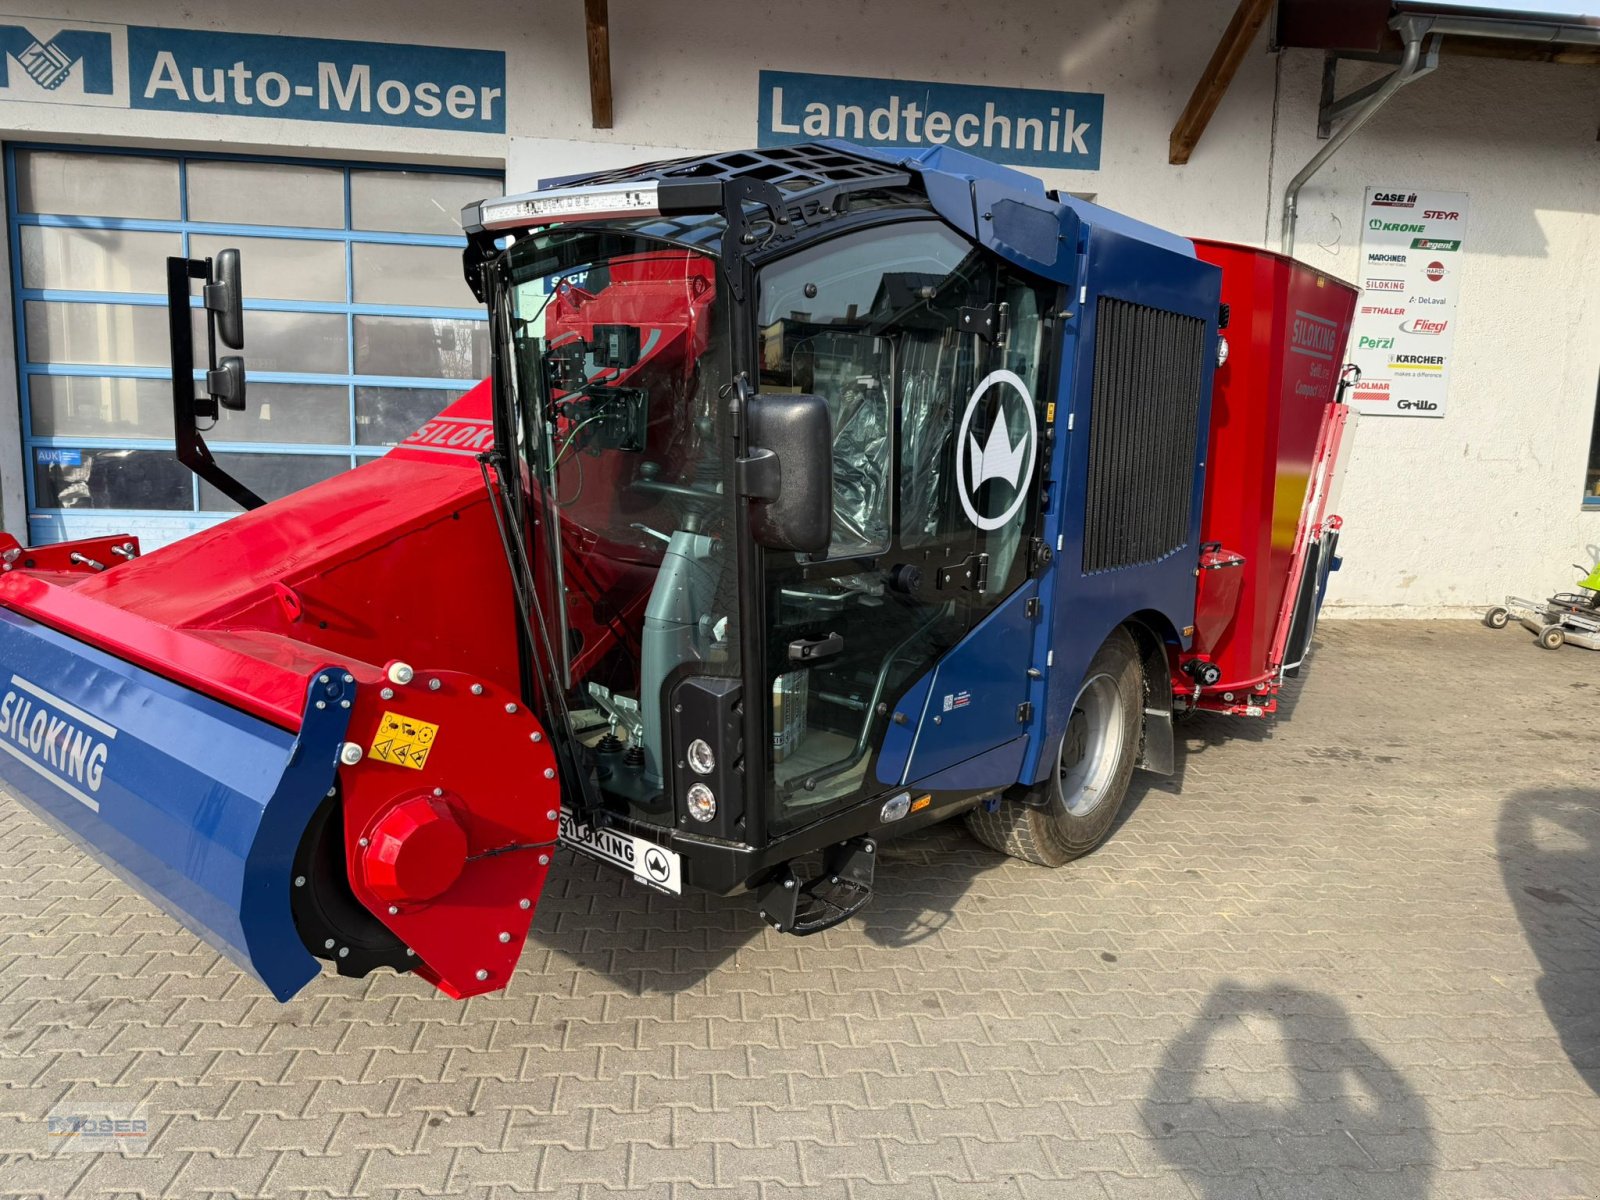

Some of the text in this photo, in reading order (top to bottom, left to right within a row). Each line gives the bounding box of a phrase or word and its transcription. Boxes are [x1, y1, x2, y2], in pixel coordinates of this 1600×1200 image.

[143, 50, 501, 120] Auto-Moser
[771, 86, 1092, 155] Landtechnik
[1374, 192, 1405, 202] CASE
[1422, 210, 1459, 221] STEYR
[1382, 222, 1425, 233] KRONE
[1418, 239, 1454, 250] Regent
[1366, 280, 1405, 290] SILOKING
[1418, 296, 1447, 305] DeLaval
[1371, 306, 1405, 316] THALER
[1412, 319, 1448, 334] Fliegl
[1291, 319, 1337, 353] SILOKING
[1358, 336, 1395, 350] Perzl
[1396, 354, 1444, 365] KÄRCHER
[1355, 382, 1390, 391] DOLMAR
[1397, 399, 1438, 412] Grillo
[0, 690, 108, 792] SILOKING
[560, 815, 635, 862] SILOKING
